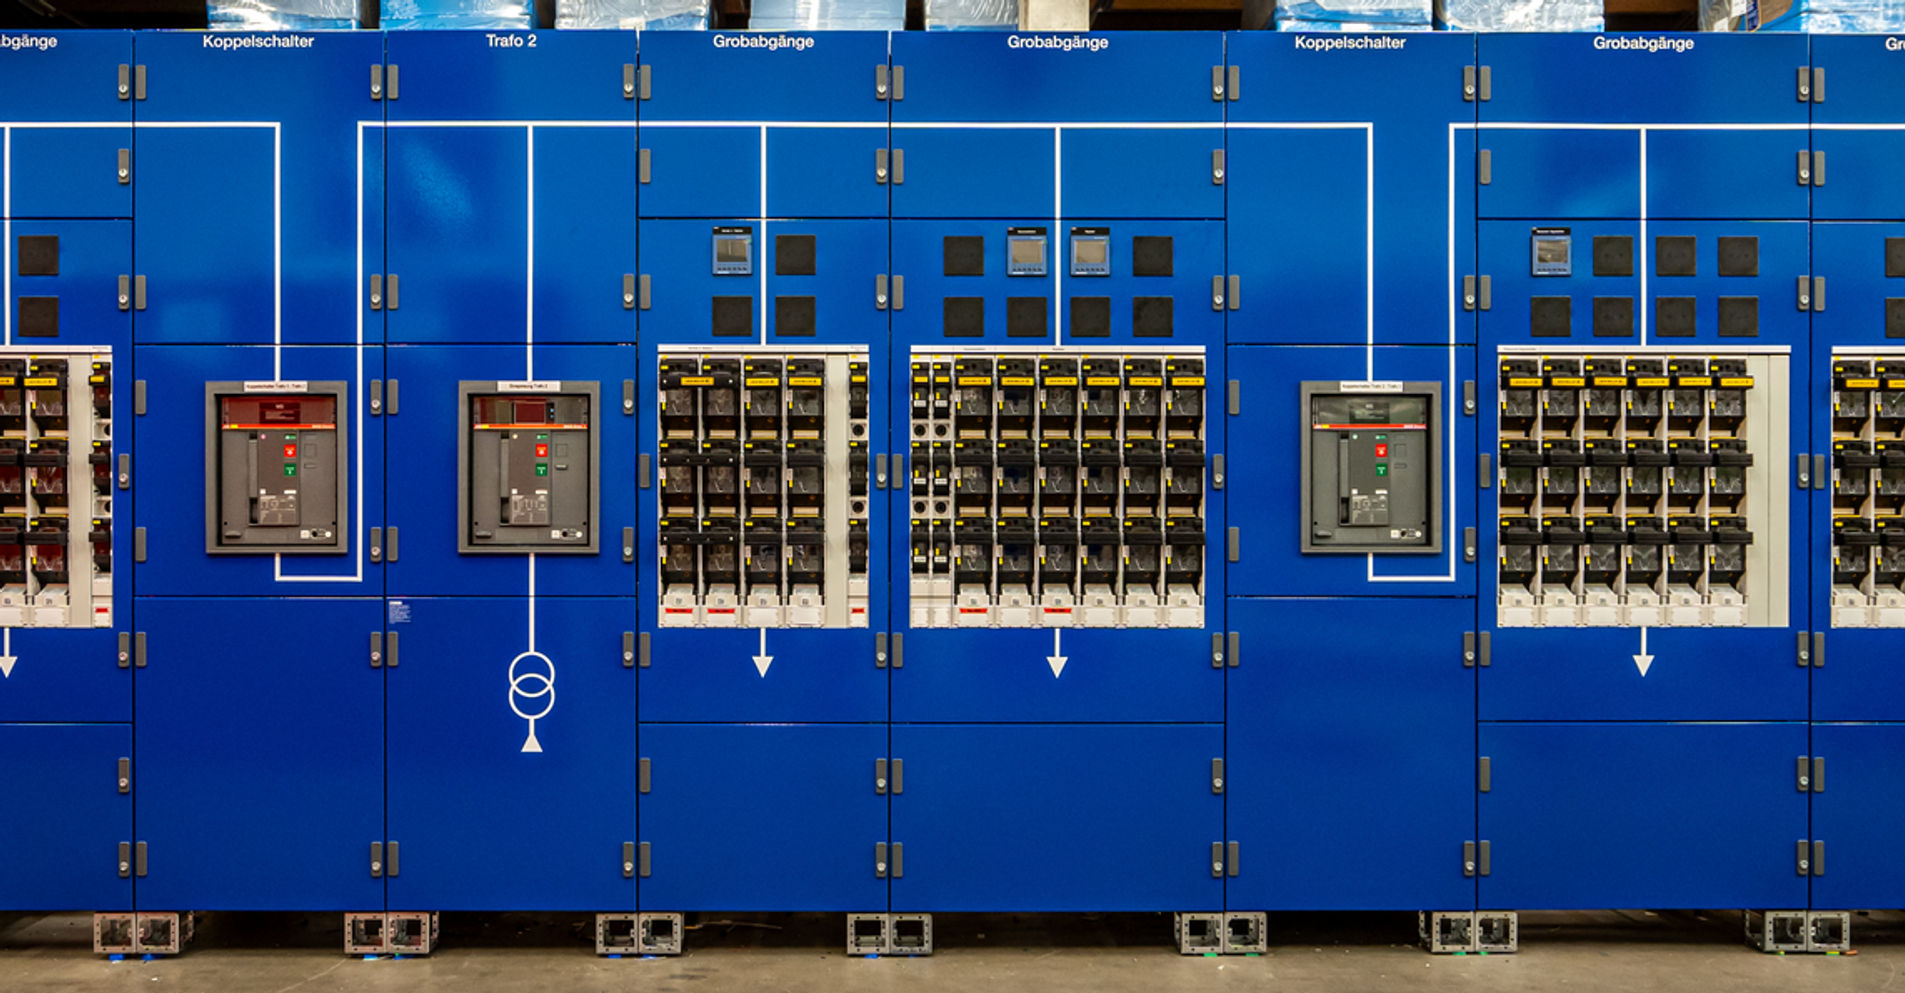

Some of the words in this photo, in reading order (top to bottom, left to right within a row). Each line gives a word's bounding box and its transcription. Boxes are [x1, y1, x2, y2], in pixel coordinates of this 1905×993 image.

[0, 34, 58, 51] bgänge
[203, 35, 315, 51] Koppelschalter
[486, 34, 524, 48] Trafo
[527, 34, 537, 48] 2
[713, 34, 815, 51] Grobabgänge
[1007, 35, 1109, 51] Grobabgänge
[1295, 35, 1407, 52] Koppelschalter
[1593, 35, 1695, 52] Grobabgänge
[1886, 37, 1905, 50] Gr
